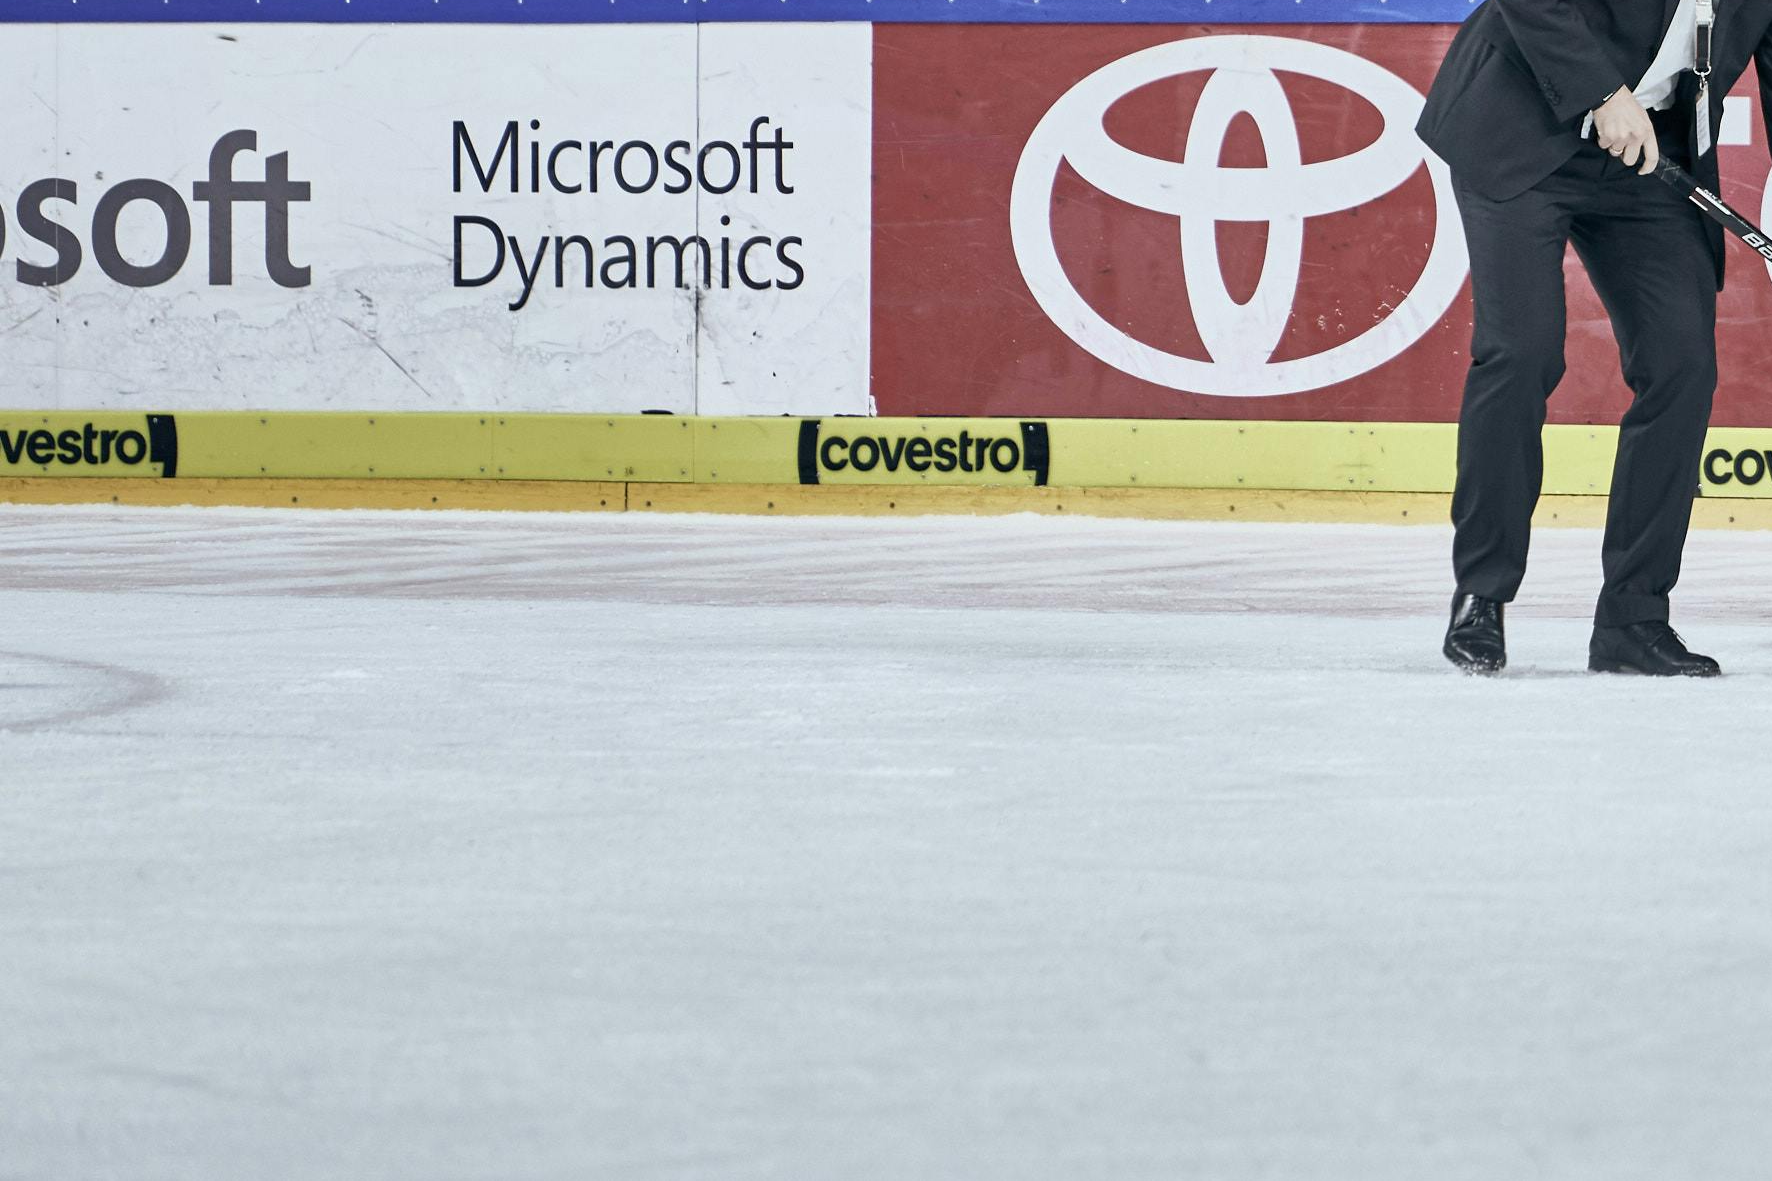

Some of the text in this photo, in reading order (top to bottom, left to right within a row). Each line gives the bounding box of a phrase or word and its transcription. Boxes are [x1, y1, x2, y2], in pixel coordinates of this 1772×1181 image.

[452, 116, 794, 195] Microsoft
[0, 129, 312, 289] soft
[453, 215, 805, 312] Dynamics
[0, 422, 148, 466] vestro
[820, 430, 1020, 473] covestro
